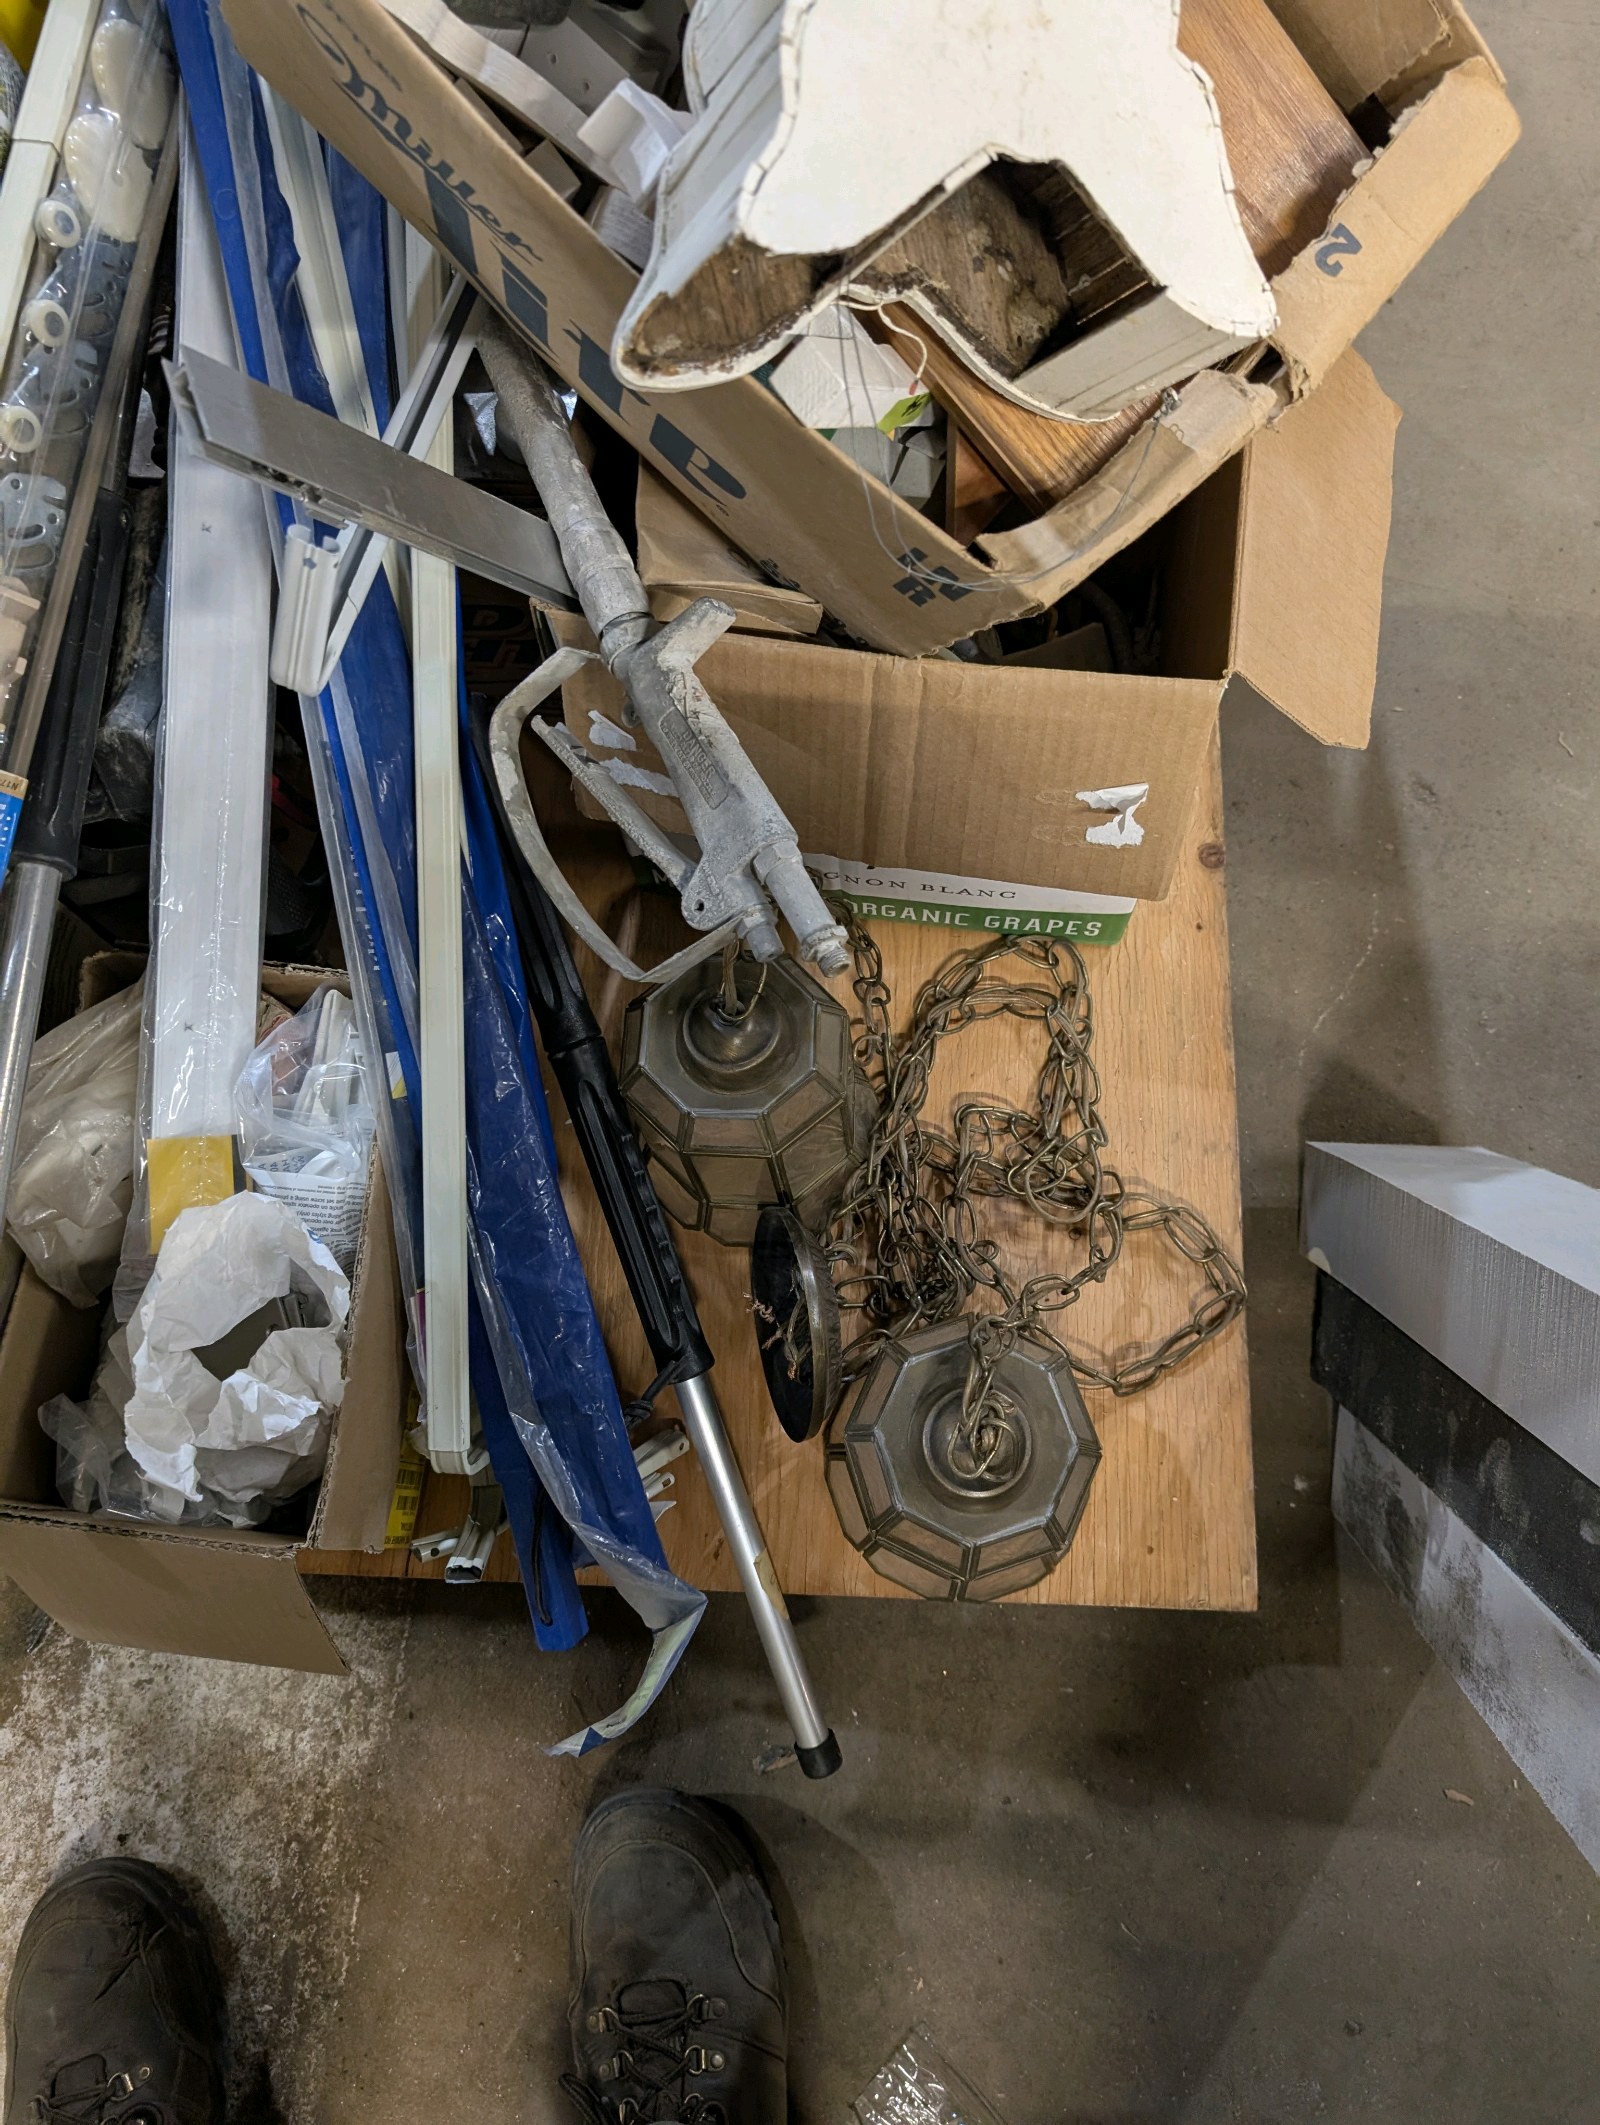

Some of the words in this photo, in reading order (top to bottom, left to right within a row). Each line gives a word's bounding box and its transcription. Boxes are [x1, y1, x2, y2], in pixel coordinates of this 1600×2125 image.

[297, 4, 544, 262] Miller
[1312, 223, 1363, 279] 2
[423, 160, 748, 508] Lite
[682, 729, 717, 779] DANGER
[920, 883, 1016, 899] BLANC
[984, 915, 1102, 936] GRAPES
